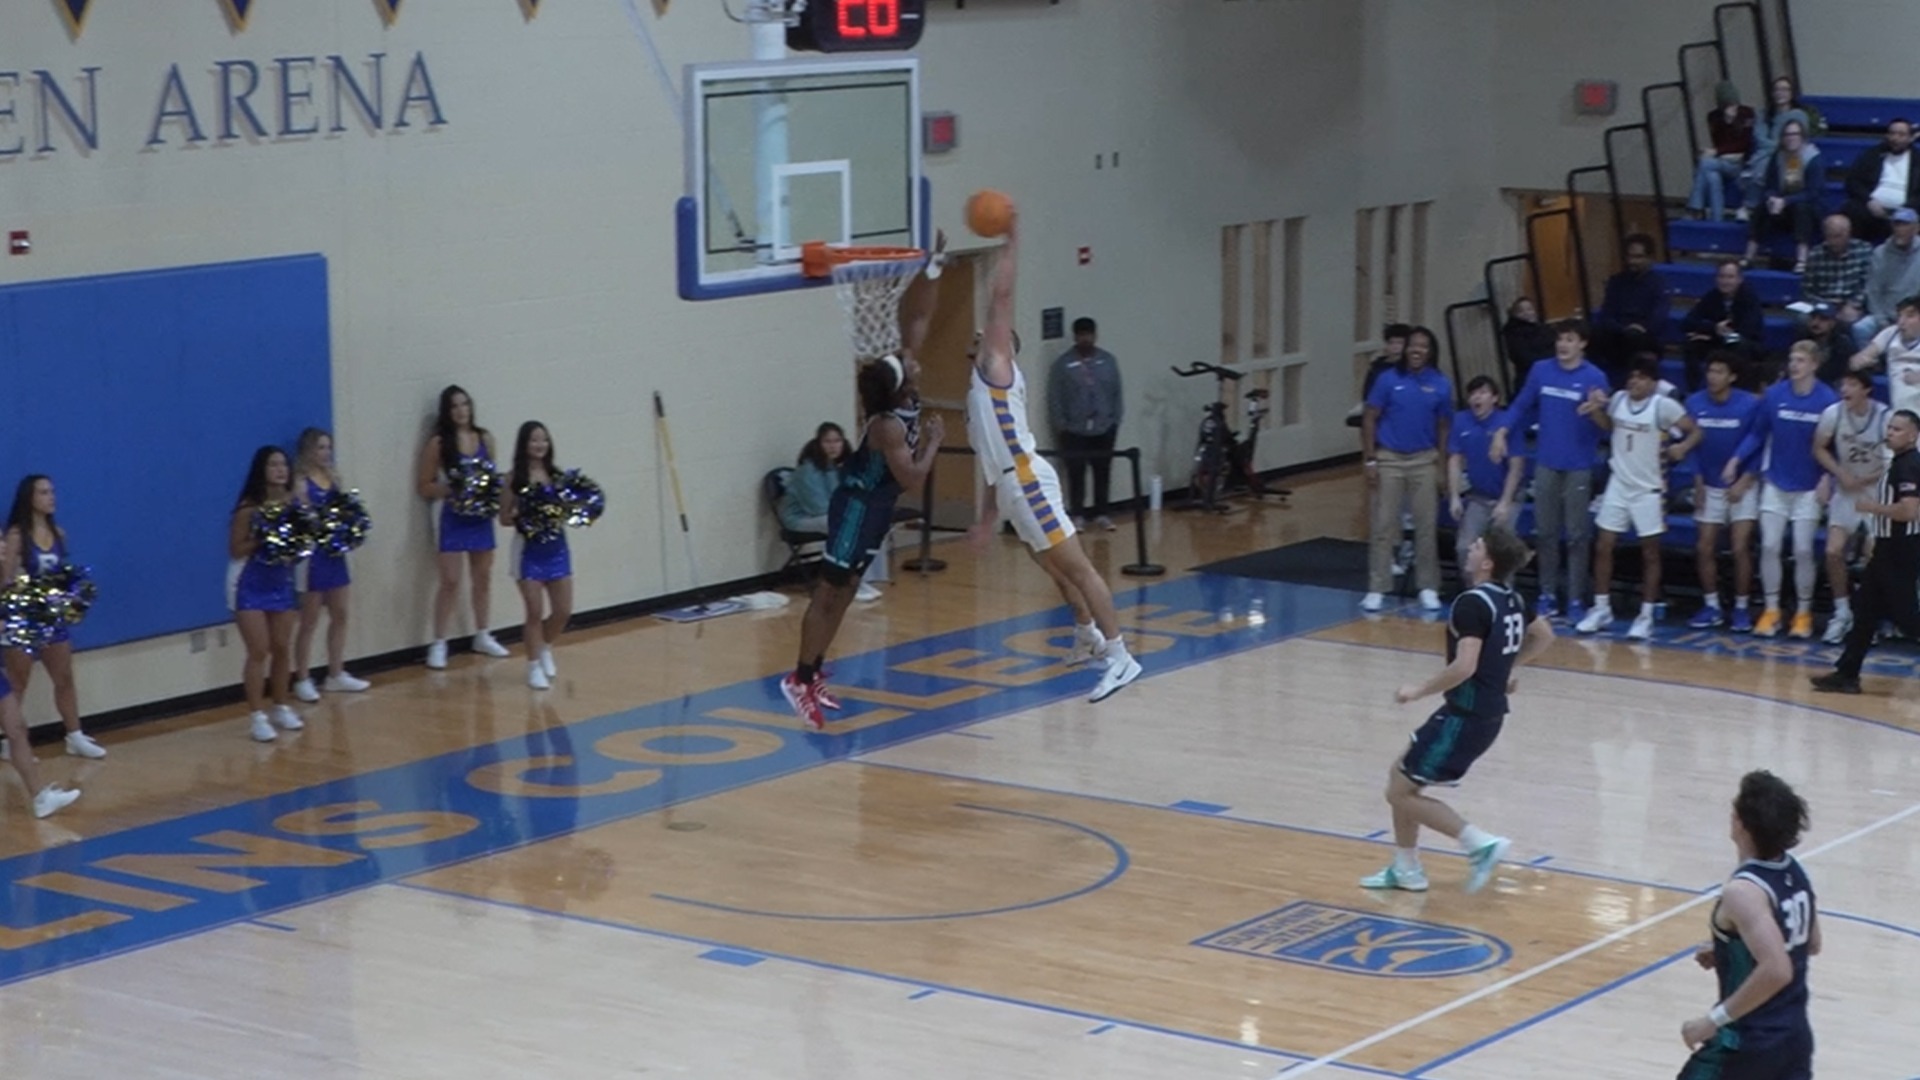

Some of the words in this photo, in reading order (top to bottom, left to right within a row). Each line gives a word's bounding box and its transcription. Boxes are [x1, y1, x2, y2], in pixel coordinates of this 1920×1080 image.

[146, 51, 448, 145] ARENA
[1502, 612, 1523, 655] 33
[466, 604, 1267, 798] COLLEGE
[1781, 890, 1811, 952] 30
